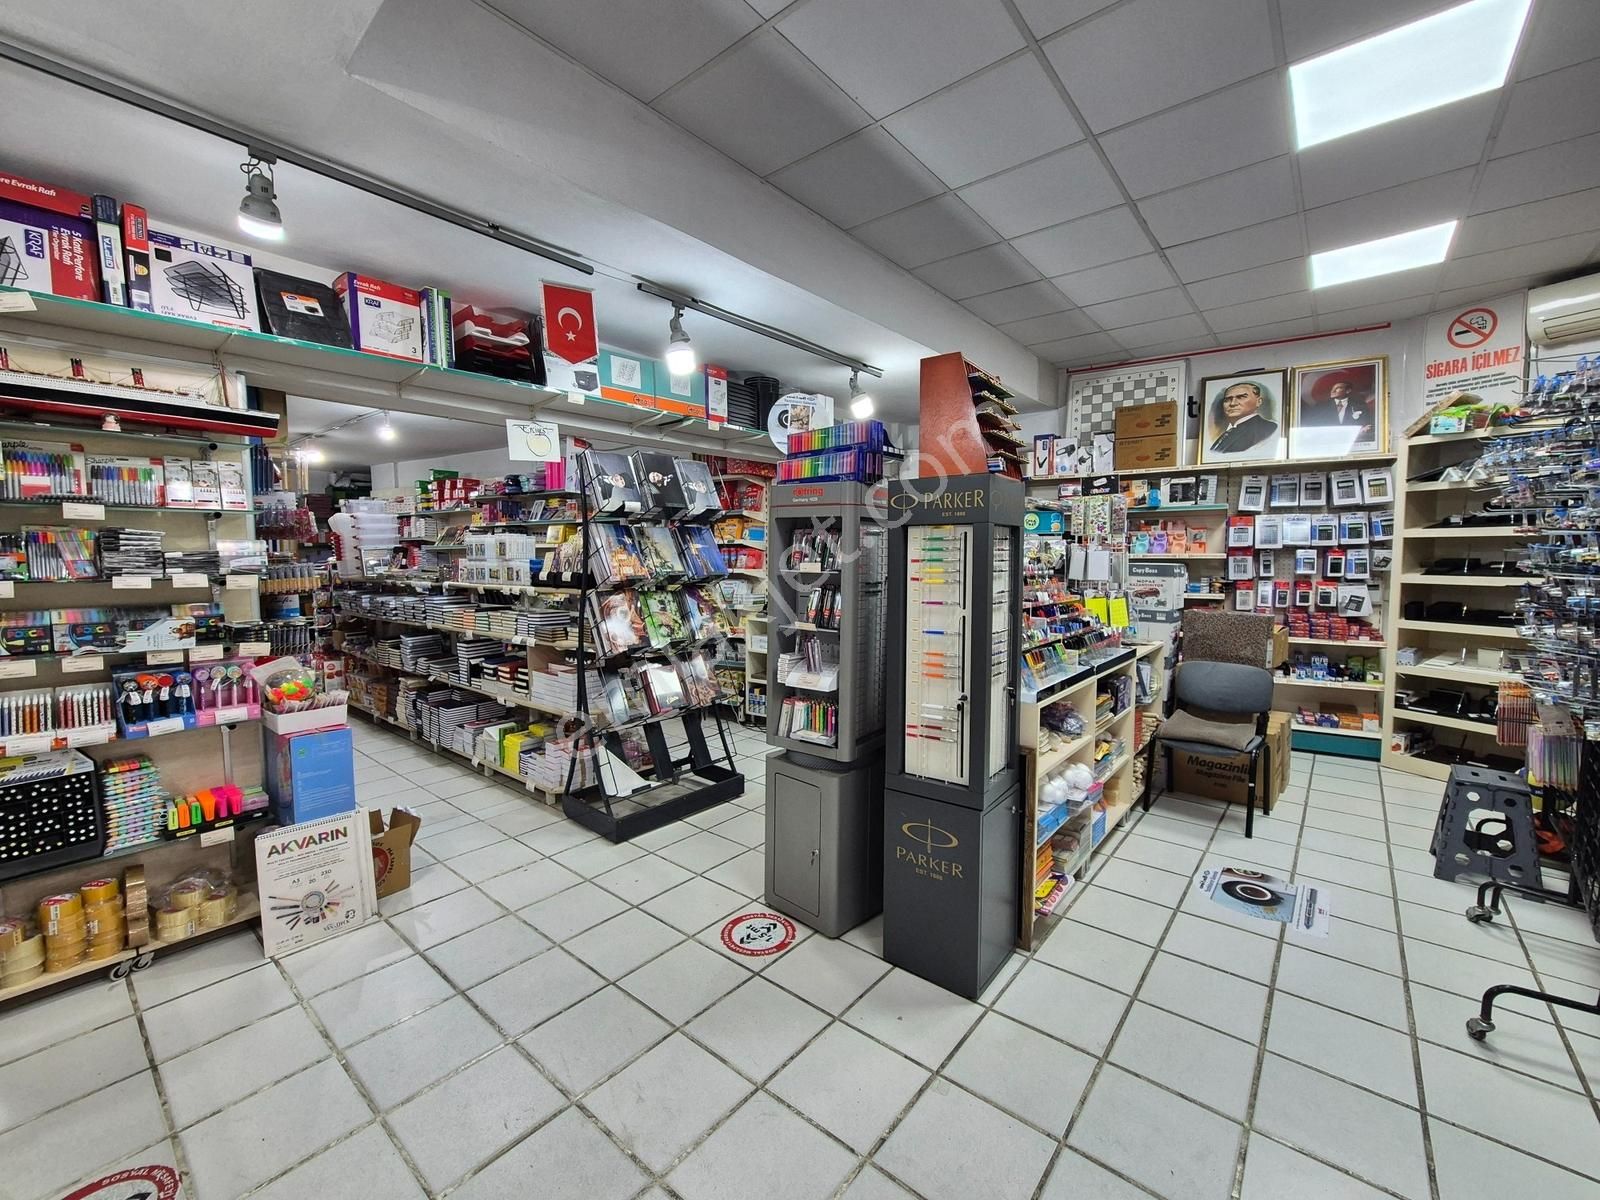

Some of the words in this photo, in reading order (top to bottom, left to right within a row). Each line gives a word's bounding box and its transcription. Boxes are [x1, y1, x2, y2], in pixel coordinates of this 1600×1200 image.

[11, 179, 37, 192] Evrak
[27, 231, 43, 258] KRAF
[60, 228, 72, 250] Evrak
[74, 254, 85, 281] Perfore
[1426, 357, 1468, 379] SİGARA
[1472, 346, 1520, 371] İÇİLMEZ
[2, 440, 28, 450] arpie
[924, 489, 984, 509] PARKER
[1187, 755, 1248, 774] Magazinli
[266, 826, 348, 858] AKVARIN
[896, 846, 963, 878] PARKER
[102, 1169, 148, 1185] SOSYAL
